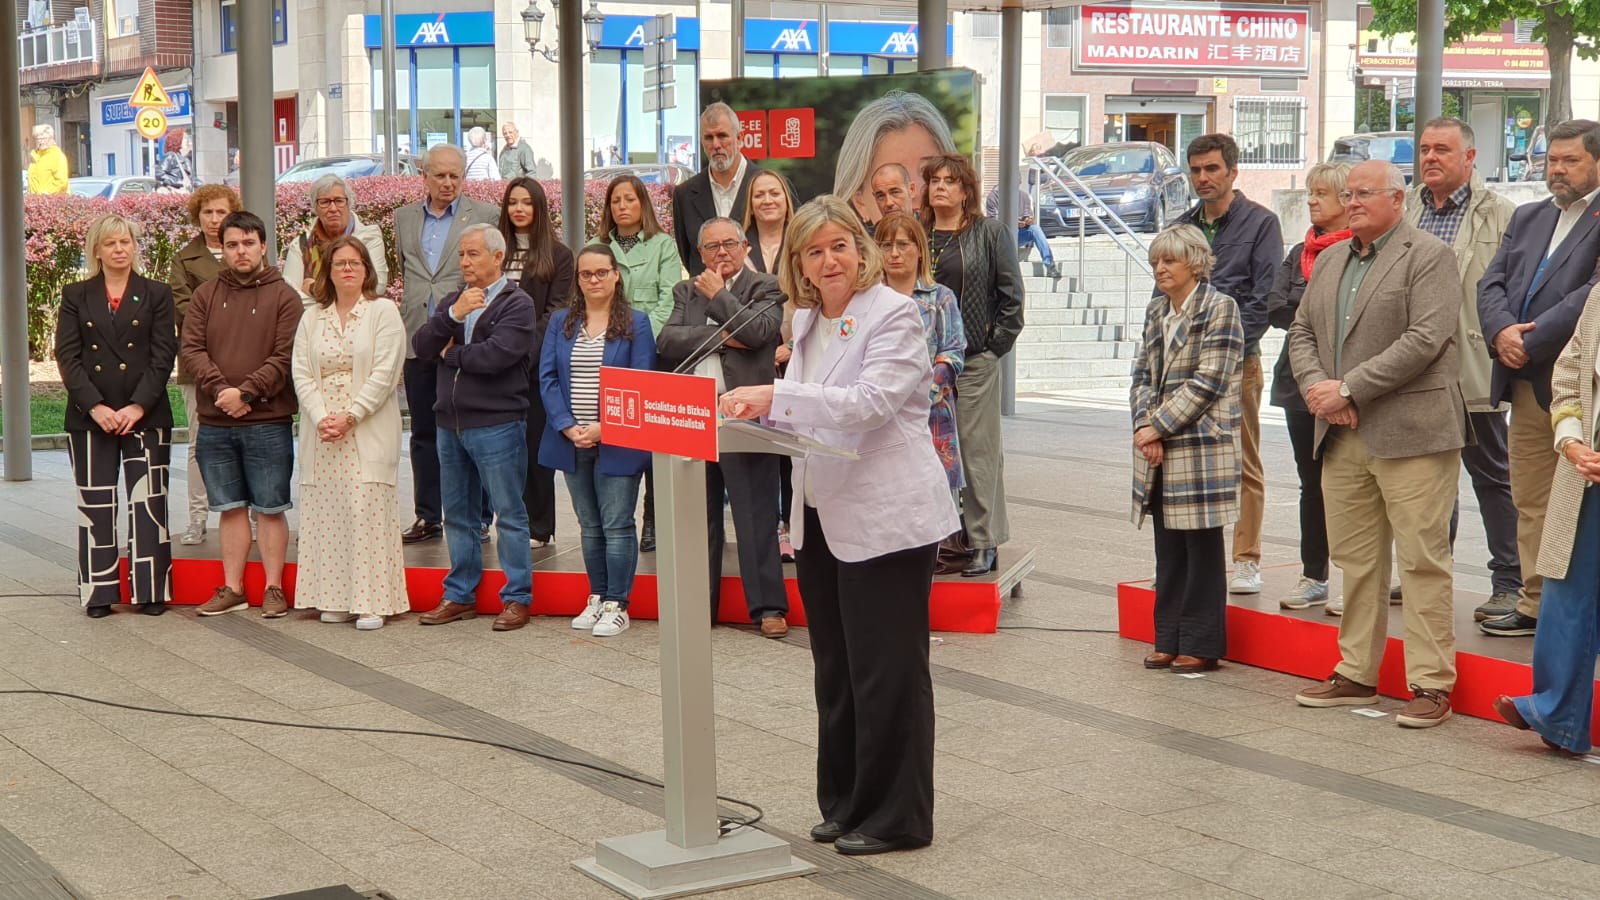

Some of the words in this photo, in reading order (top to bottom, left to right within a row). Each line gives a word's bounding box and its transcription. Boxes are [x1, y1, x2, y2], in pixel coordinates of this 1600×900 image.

[411, 20, 450, 44] AXA
[1091, 12, 1232, 38] RESTAURANTE
[1236, 16, 1298, 40] CHINO
[771, 27, 811, 51] AXA
[880, 31, 919, 53] AXA
[1087, 44, 1199, 60] MANDARIN
[1207, 43, 1302, 62] 汇丰酒店
[1360, 56, 1415, 66] HERBORISTERÍA
[1484, 80, 1504, 88] TERRA
[105, 103, 133, 121] SUPER
[142, 117, 160, 128] 20
[739, 119, 762, 131] E-EE
[607, 405, 621, 416] PSOE
[644, 400, 677, 413] Socialistas
[677, 403, 686, 415] de
[686, 404, 711, 417] Bizkaia
[644, 413, 671, 424] Bizkaiko
[671, 416, 706, 431] Sozialistak
